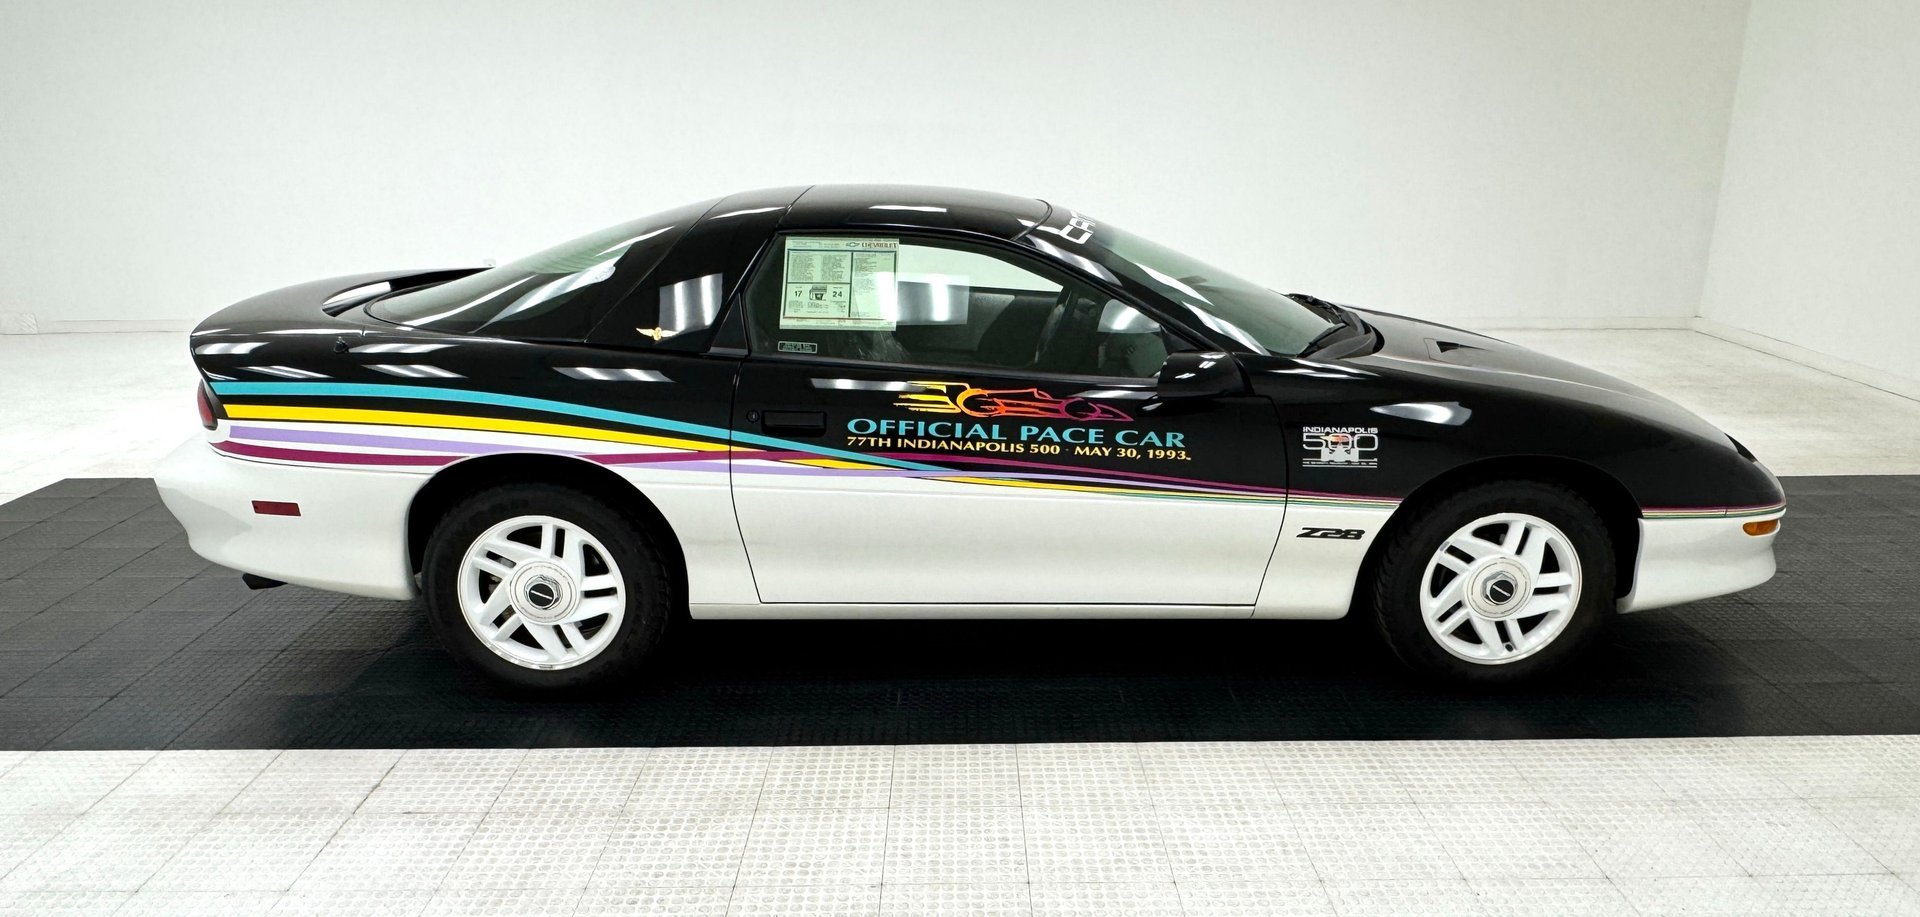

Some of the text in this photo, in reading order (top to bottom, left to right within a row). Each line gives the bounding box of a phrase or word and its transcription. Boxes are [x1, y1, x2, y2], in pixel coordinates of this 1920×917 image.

[794, 290, 803, 298] 17
[832, 290, 843, 298] 24
[847, 418, 1185, 448] OFFICIAL PACE CAR
[1302, 426, 1379, 434] INDIANAPOLIS
[847, 436, 892, 448] 77TH
[897, 438, 1025, 453] INDIANAPOLIS
[1029, 443, 1061, 455] 500
[1074, 446, 1112, 457] MAY
[1116, 448, 1142, 460] 30,
[1302, 432, 1379, 451] 500
[1295, 527, 1366, 540] Z28
